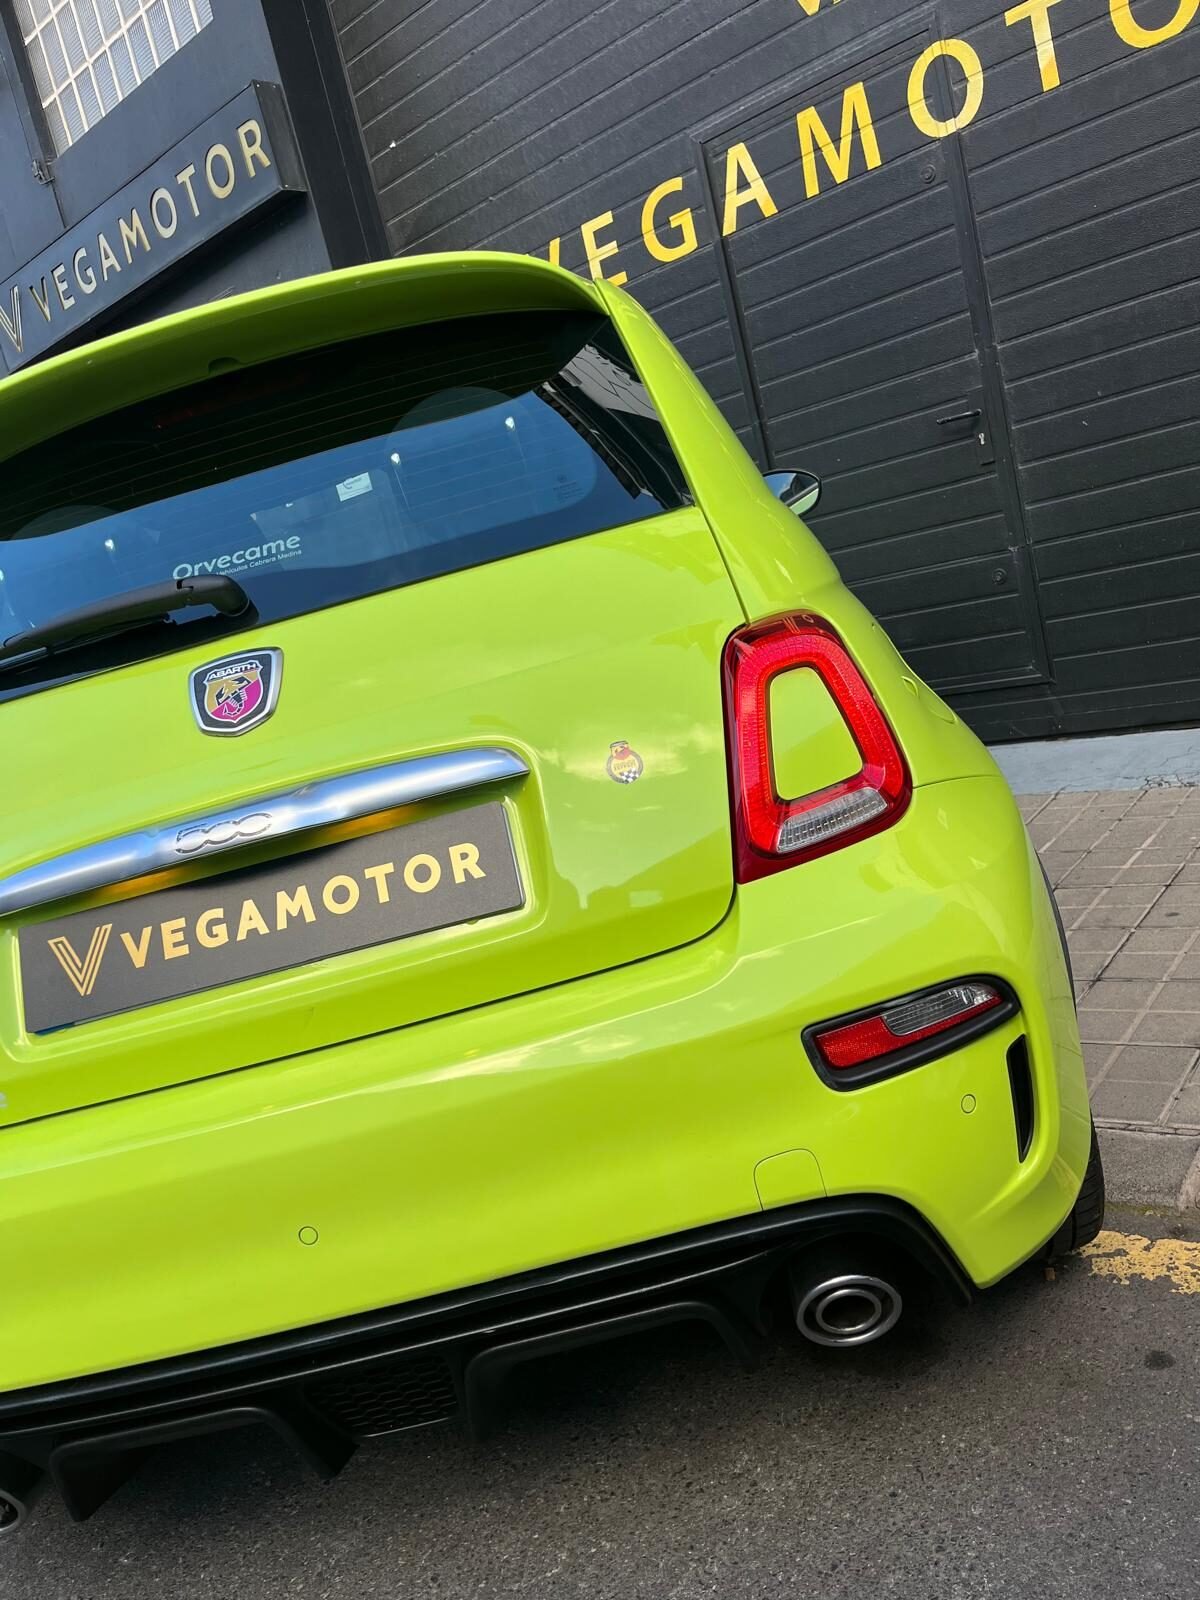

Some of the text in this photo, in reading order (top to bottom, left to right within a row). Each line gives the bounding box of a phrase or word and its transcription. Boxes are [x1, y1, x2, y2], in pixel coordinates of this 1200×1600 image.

[28, 119, 271, 322] VEGAMOTOR
[172, 535, 301, 580] Orvecame
[209, 663, 257, 680] ABARTH
[119, 842, 487, 970] VEGAMOTOR
